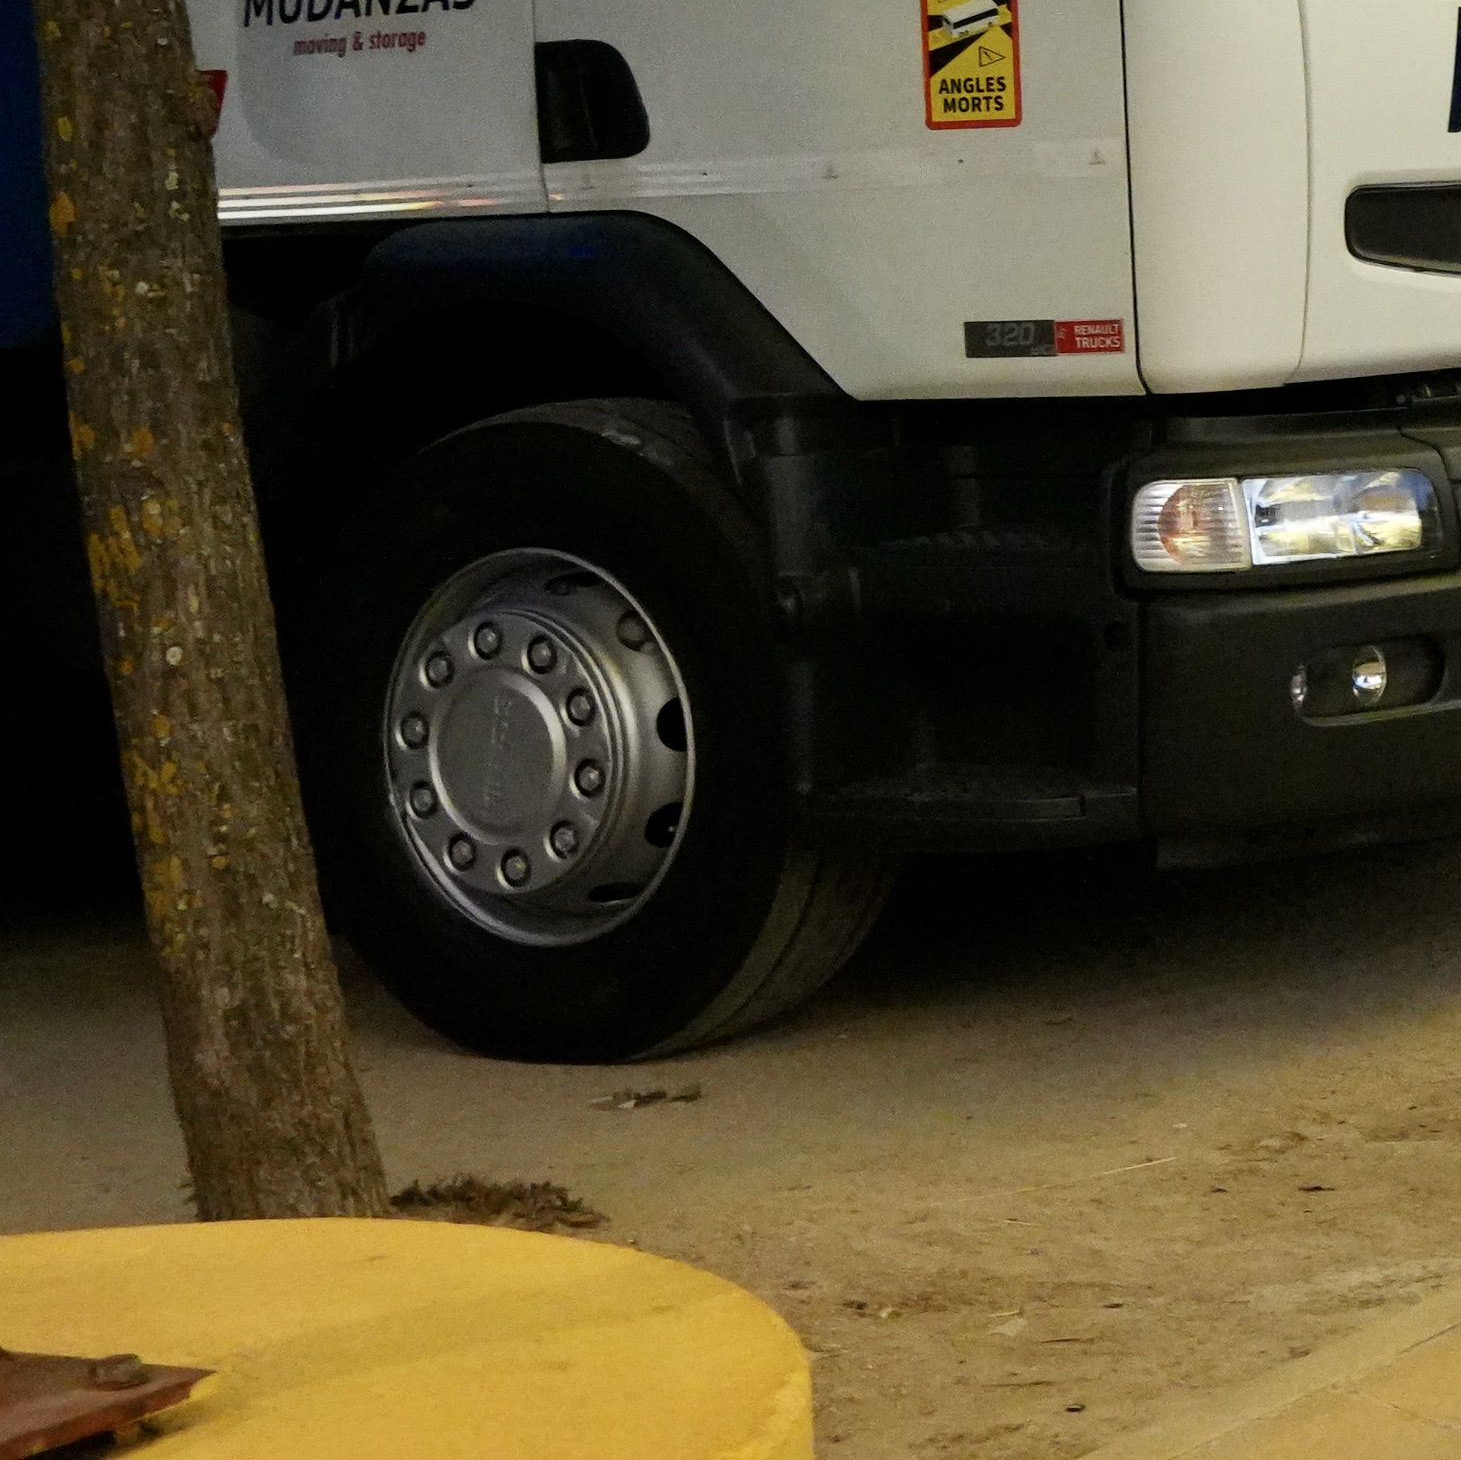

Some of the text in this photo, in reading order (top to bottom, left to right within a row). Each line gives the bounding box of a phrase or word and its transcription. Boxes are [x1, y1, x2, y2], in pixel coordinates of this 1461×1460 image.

[293, 30, 427, 58] moving & storage
[939, 76, 1006, 94] ANGLES
[943, 96, 1005, 113] MORTS
[985, 321, 1036, 347] 320
[1074, 324, 1119, 336] RENAULT
[1075, 337, 1121, 348] TRUCKS
